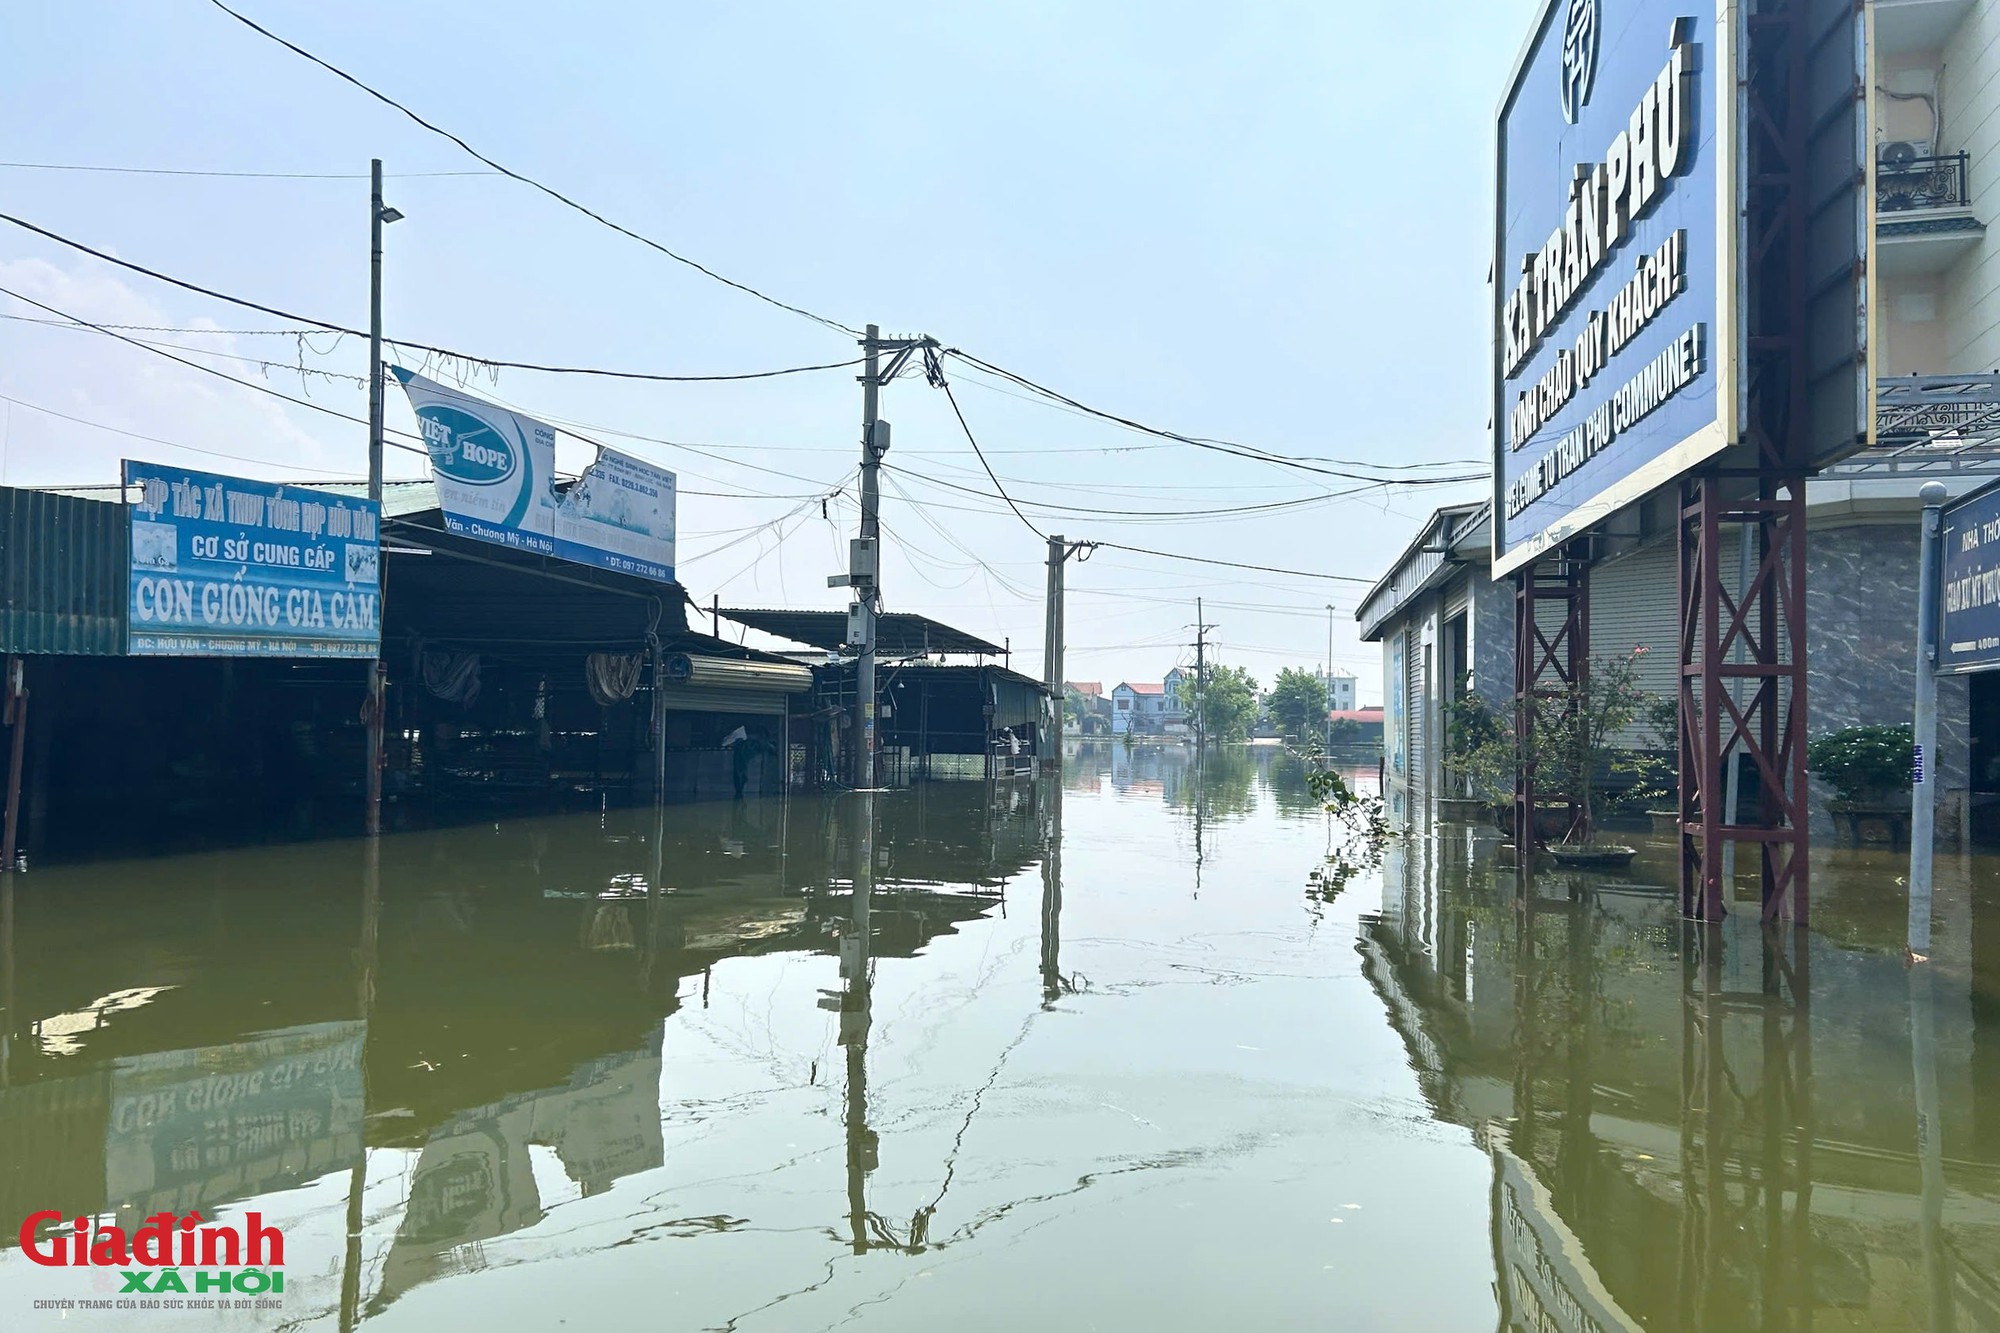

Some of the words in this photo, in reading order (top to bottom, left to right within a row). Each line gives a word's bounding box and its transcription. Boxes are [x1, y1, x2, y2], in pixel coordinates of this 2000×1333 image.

[1533, 163, 1605, 338] TRẦN
[1606, 16, 1700, 249] PHÚ
[1511, 388, 1539, 452] KÍNH
[1539, 349, 1573, 423] CHÀO
[1575, 310, 1606, 389] QUÝ
[1608, 229, 1686, 357] KHÁCH!
[1505, 460, 1543, 520] WELCOME
[1544, 448, 1556, 490] TO
[1556, 424, 1584, 480] TRAN
[1586, 400, 1611, 458] PHU
[1613, 323, 1701, 435] COMMUNE!
[462, 441, 508, 472] HOPE
[172, 477, 201, 519] TÁC
[203, 482, 225, 522] XÃ
[266, 486, 300, 532] TỔNG
[302, 501, 326, 540] HỢP
[327, 500, 351, 538] HỮU
[352, 505, 376, 541] VĂN
[192, 535, 220, 558] CƠ
[224, 532, 250, 561] SỞ
[253, 542, 299, 566] CUNG
[304, 543, 335, 569] CẤP
[471, 523, 505, 543] Chương
[507, 531, 520, 546] Mỹ
[526, 536, 538, 549] Hà
[539, 540, 553, 554] Nội
[1962, 523, 1979, 552] NHÀ
[610, 556, 622, 567] ĐT:
[622, 560, 635, 571] 097
[636, 564, 648, 575] 272
[136, 577, 194, 622] CON
[202, 565, 281, 625] GIỐNG
[286, 588, 326, 628] GIA
[1978, 637, 1999, 651] 400m
